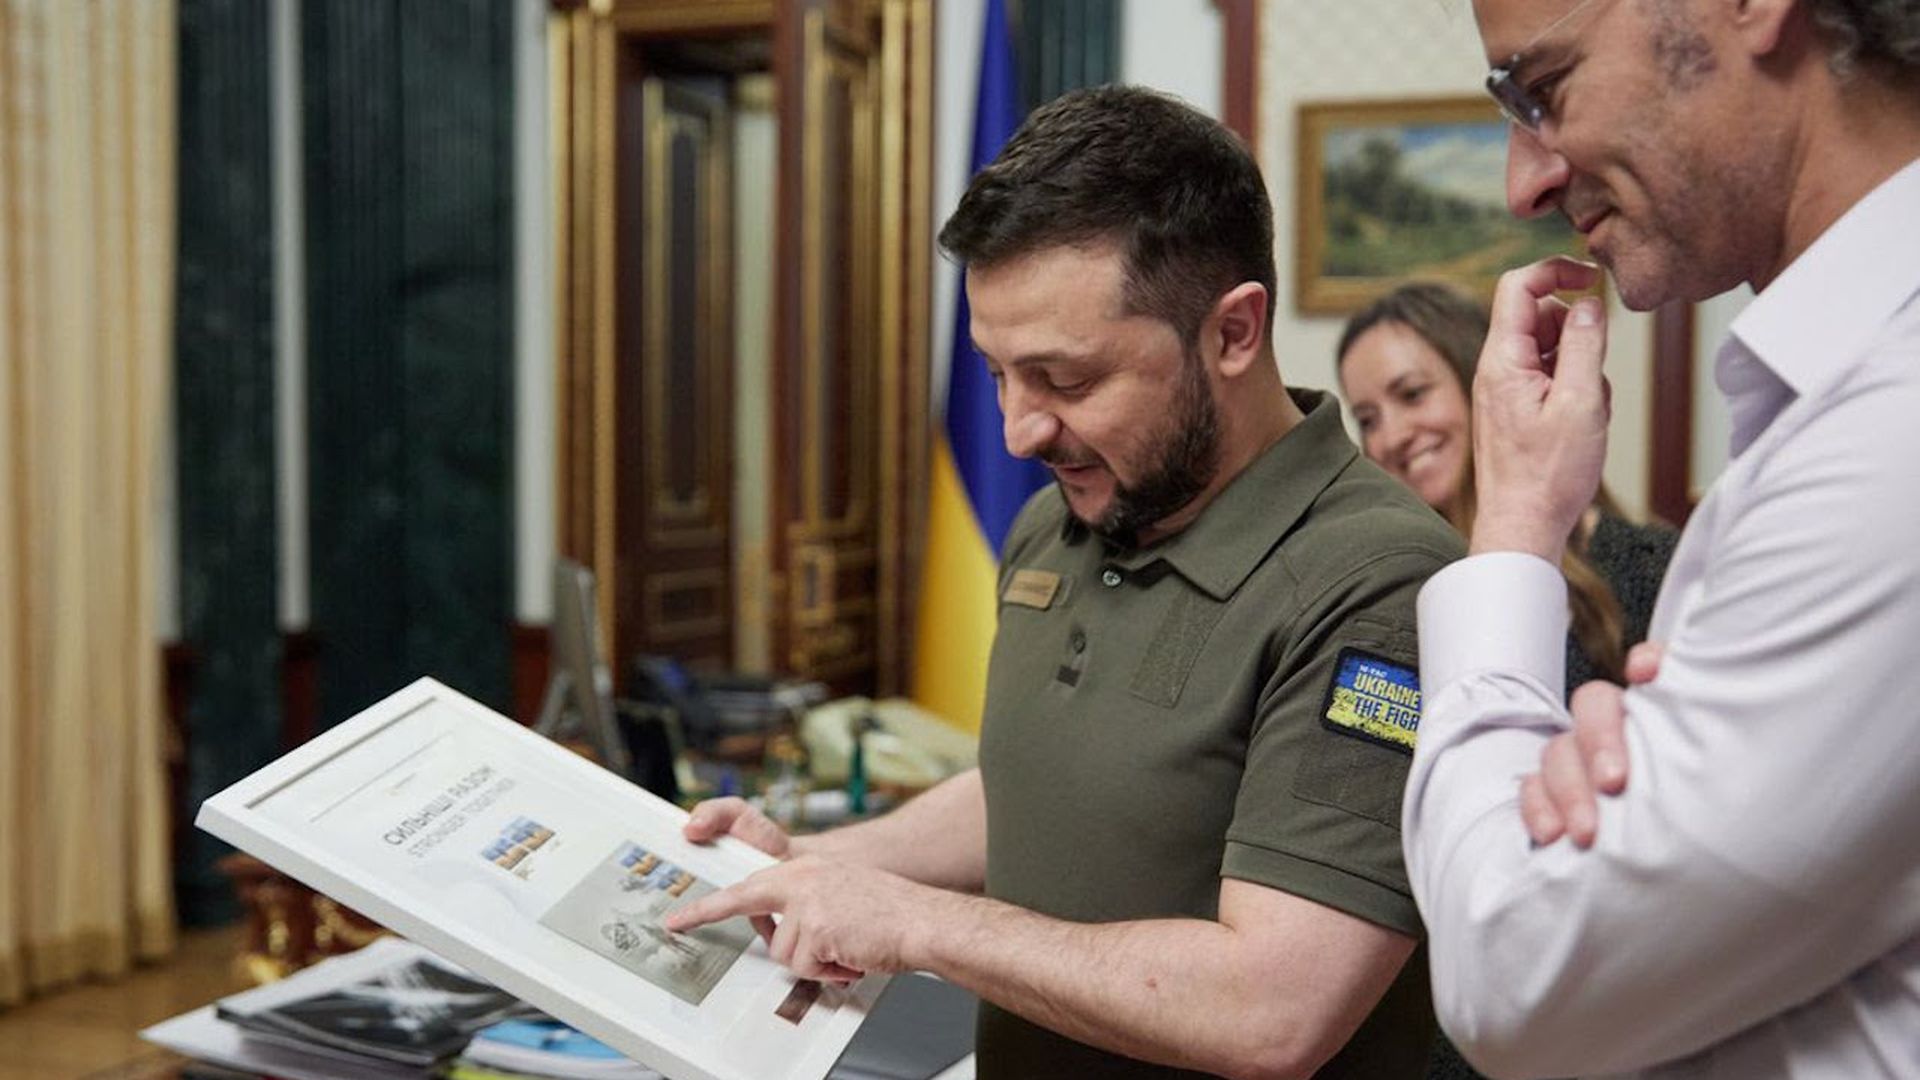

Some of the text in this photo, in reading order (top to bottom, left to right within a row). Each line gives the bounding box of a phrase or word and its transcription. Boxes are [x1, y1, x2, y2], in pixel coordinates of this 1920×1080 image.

[1354, 672, 1422, 708] UKRAINE
[1354, 696, 1420, 731] THE FIGH
